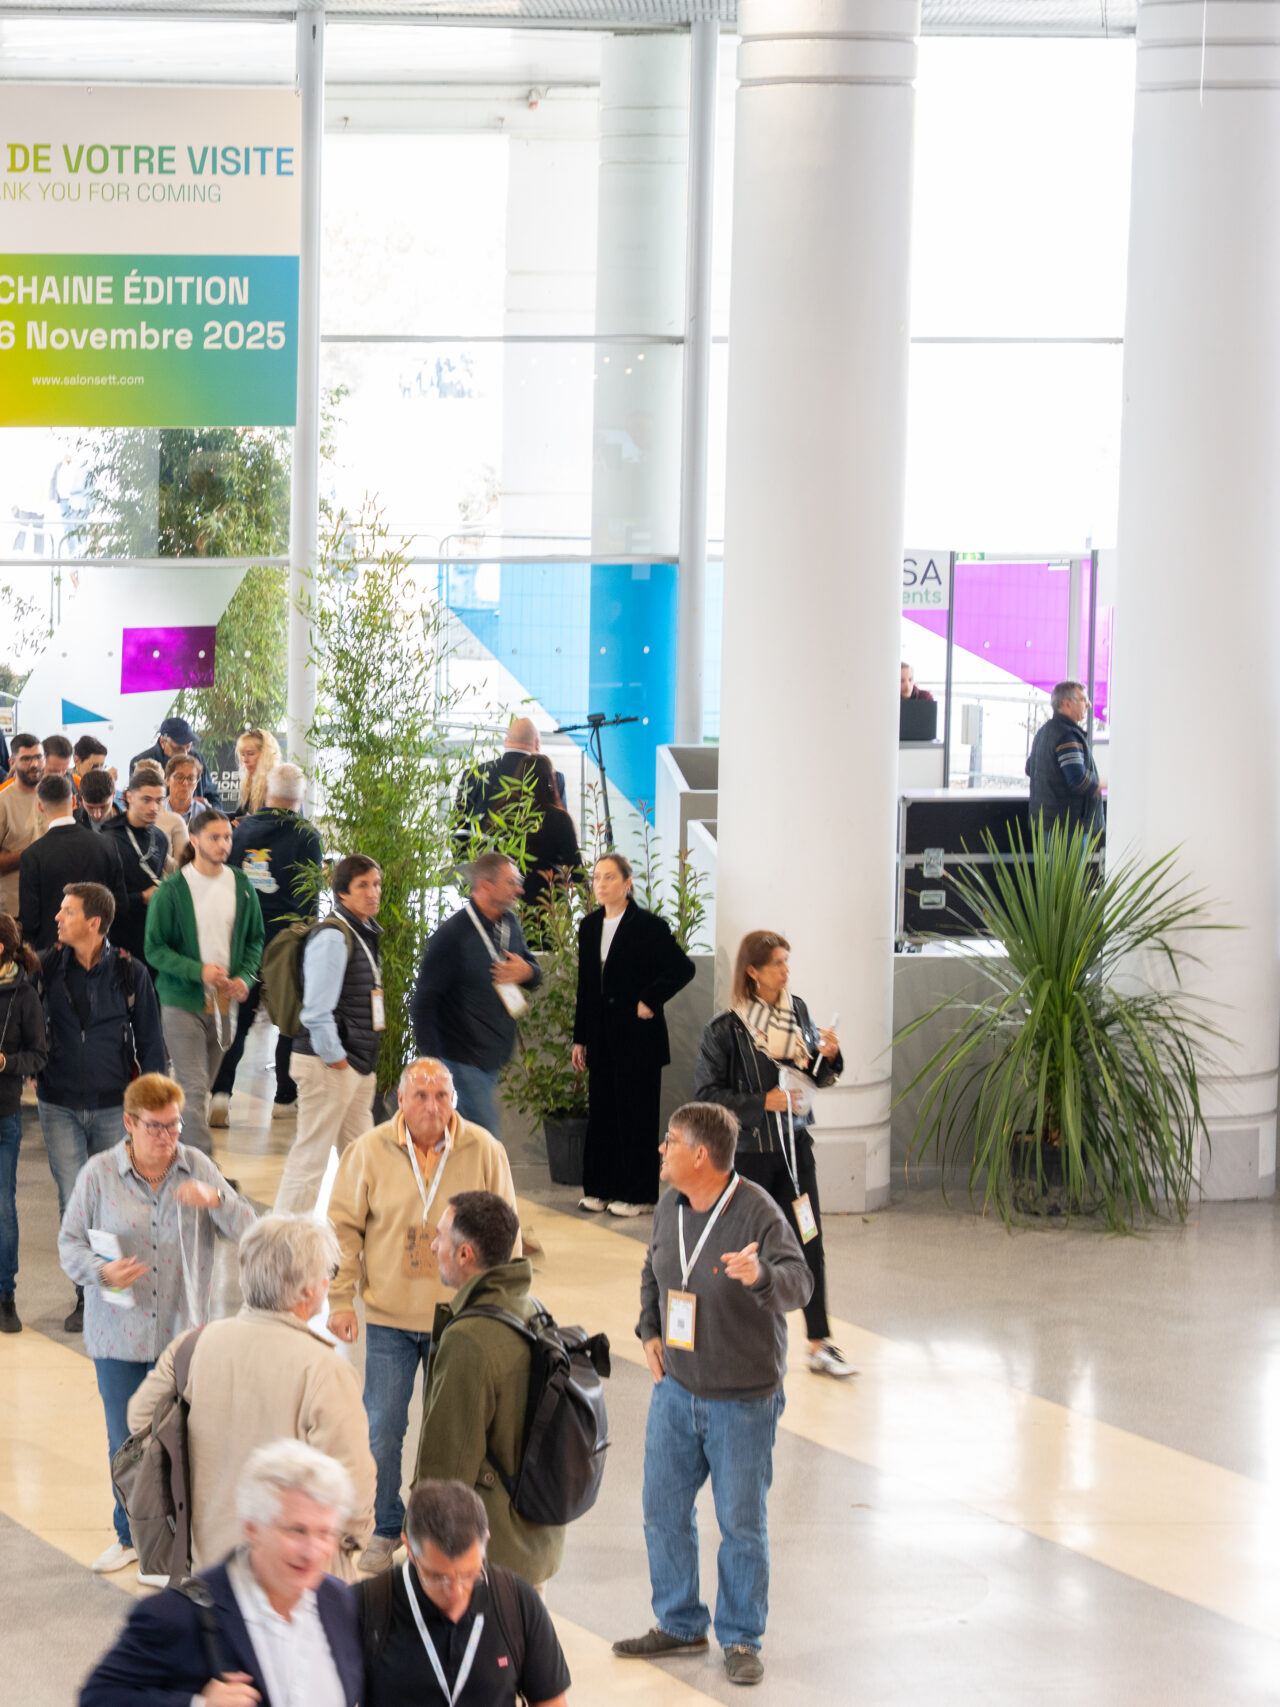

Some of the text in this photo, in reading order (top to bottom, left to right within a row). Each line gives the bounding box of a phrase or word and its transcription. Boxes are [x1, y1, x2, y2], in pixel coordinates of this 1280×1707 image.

[6, 143, 52, 173] DE
[62, 144, 176, 175] VOTRE
[187, 145, 294, 176] VISITE
[38, 182, 81, 201] YOU
[89, 182, 130, 202] FOR
[137, 183, 221, 203] COMING
[124, 268, 249, 305] ÉDITION
[26, 320, 193, 350] Novembre
[203, 320, 286, 350] 2025
[32, 374, 145, 386] www.salonsett.com
[903, 588, 942, 604] ents
